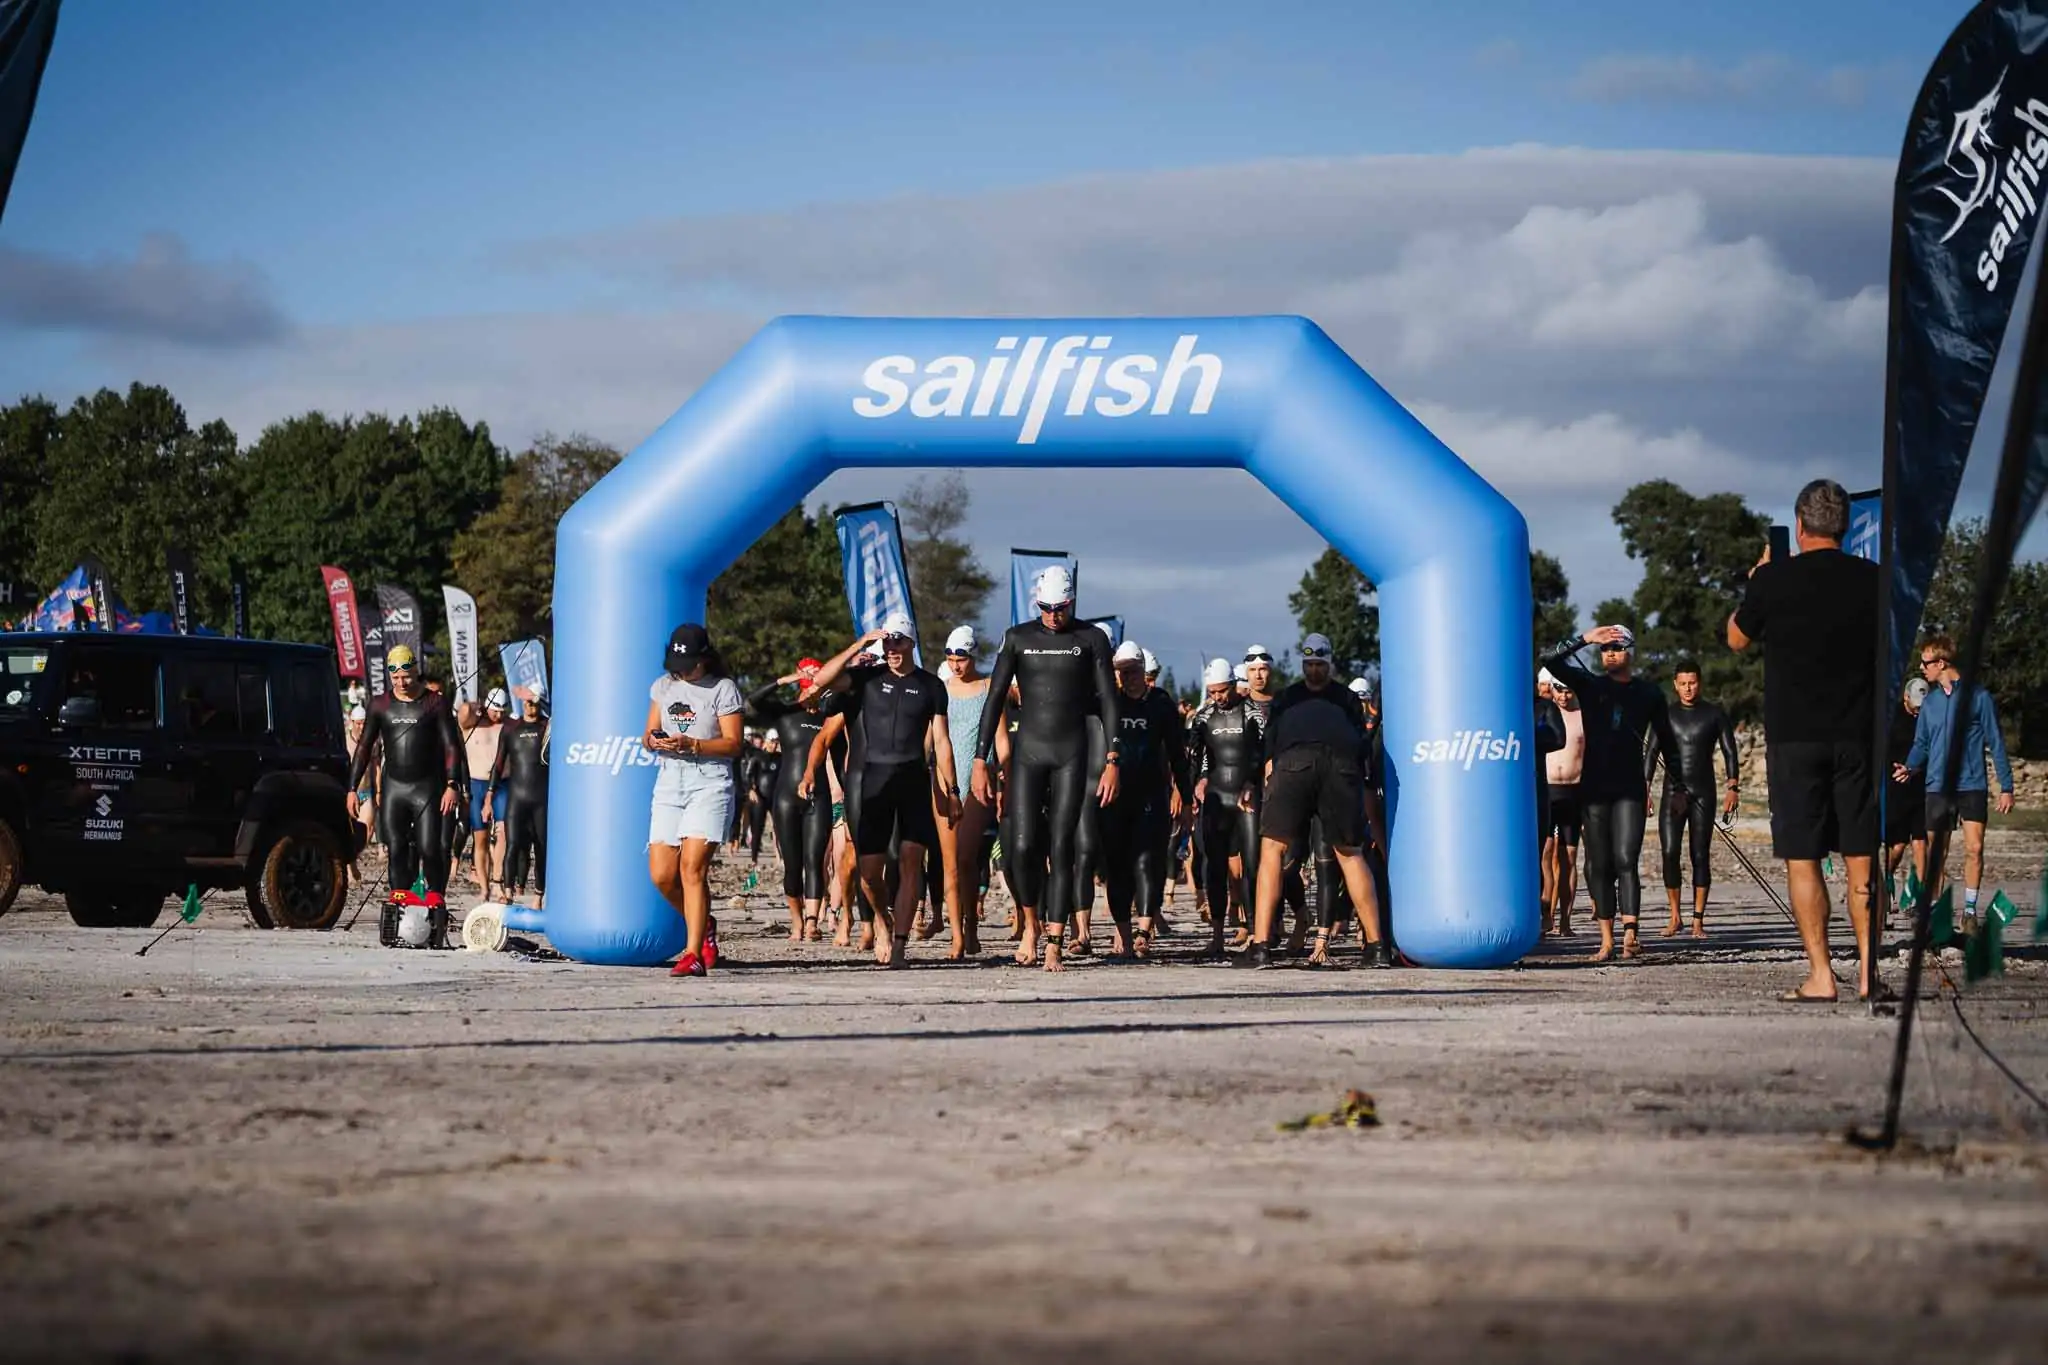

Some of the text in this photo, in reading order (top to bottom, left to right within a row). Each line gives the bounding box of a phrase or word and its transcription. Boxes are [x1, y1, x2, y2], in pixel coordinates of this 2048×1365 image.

[1977, 97, 2048, 292] sailfish
[852, 334, 1223, 445] sailfish
[1120, 717, 1148, 730] TYR
[69, 746, 142, 761] XTERRA
[565, 735, 662, 775] sailfis
[1412, 730, 1520, 771] sailfish
[76, 767, 135, 780] SOUTH AFRICA
[85, 819, 124, 829] SUZUKI
[84, 830, 122, 841] HERMANUS
